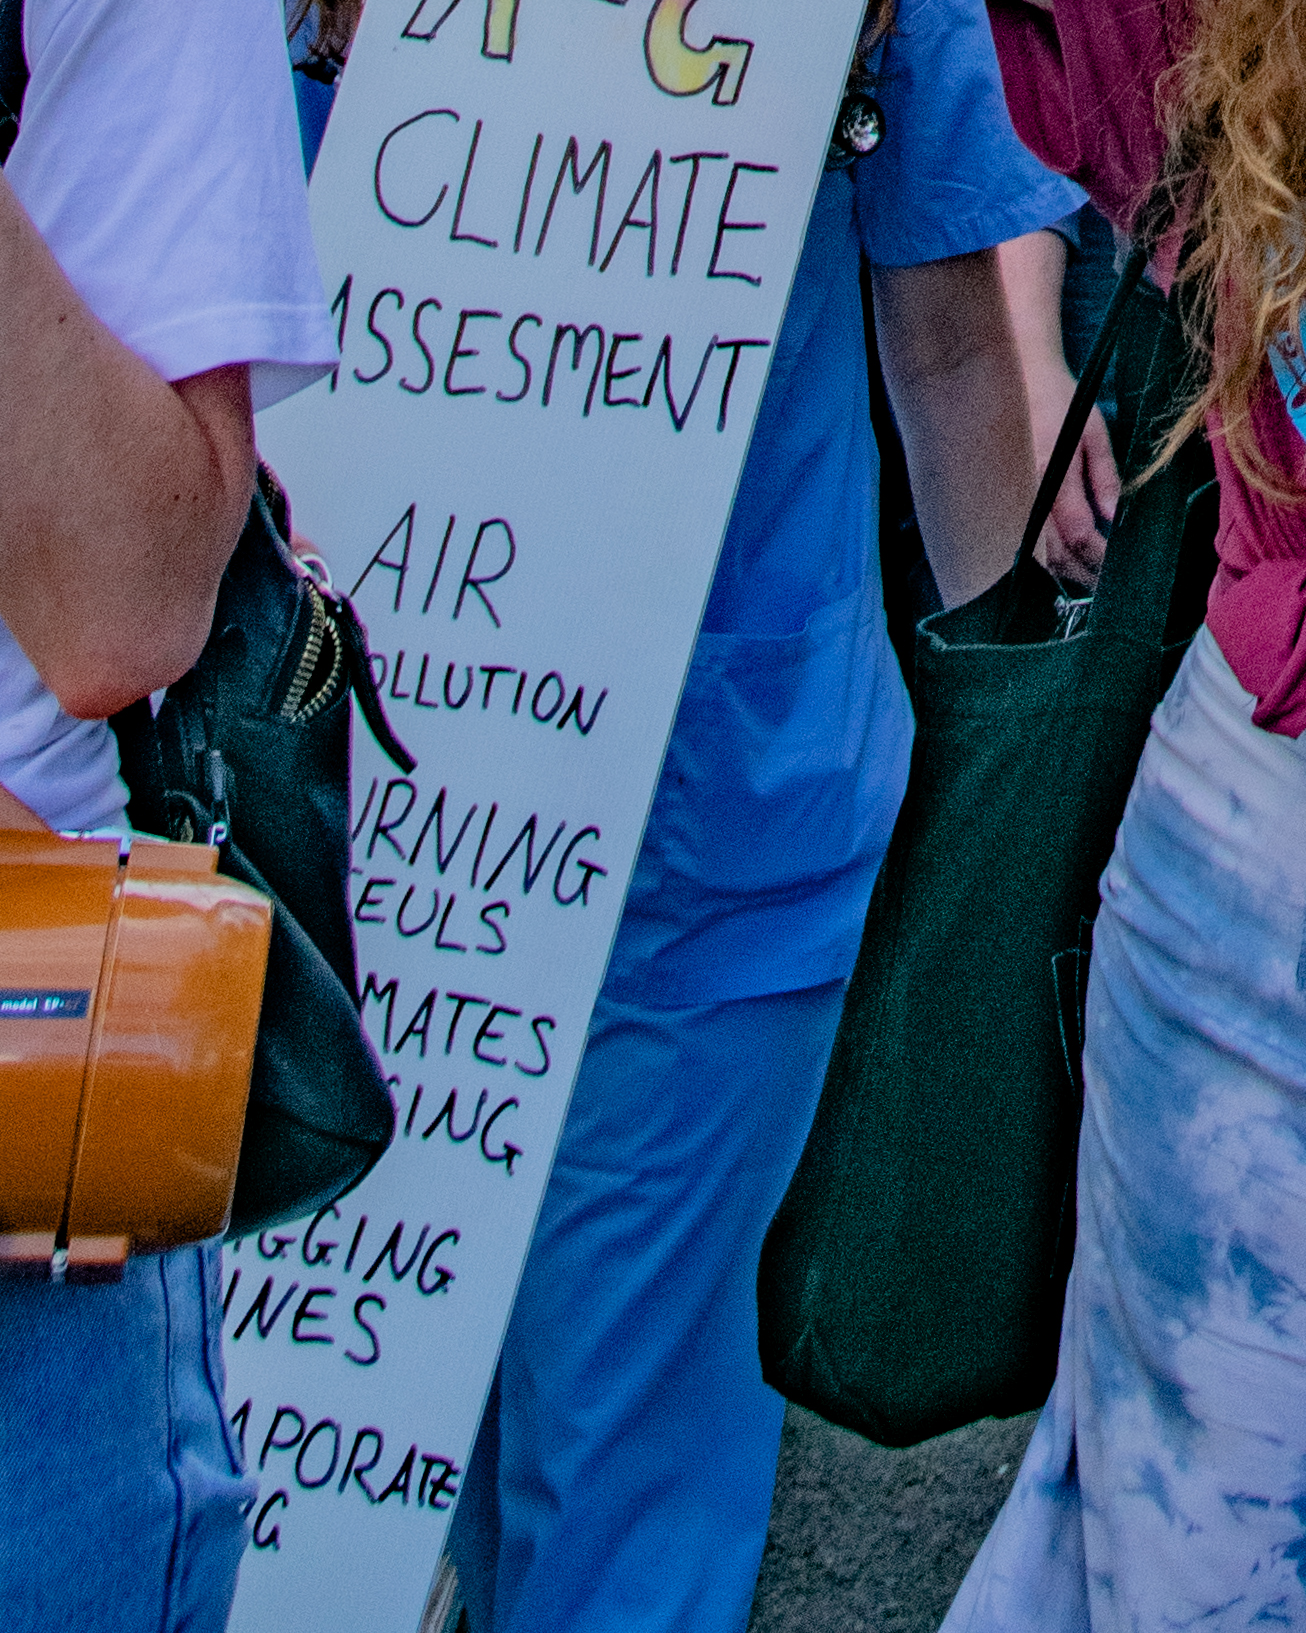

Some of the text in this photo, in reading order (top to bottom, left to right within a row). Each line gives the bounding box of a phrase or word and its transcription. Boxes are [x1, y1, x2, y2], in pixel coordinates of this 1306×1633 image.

[374, 109, 779, 286] CLIMATE
[350, 501, 517, 628] AIR
[368, 648, 609, 736] OLLUTION
[352, 867, 511, 955] EULS
[222, 1267, 388, 1367] INES
